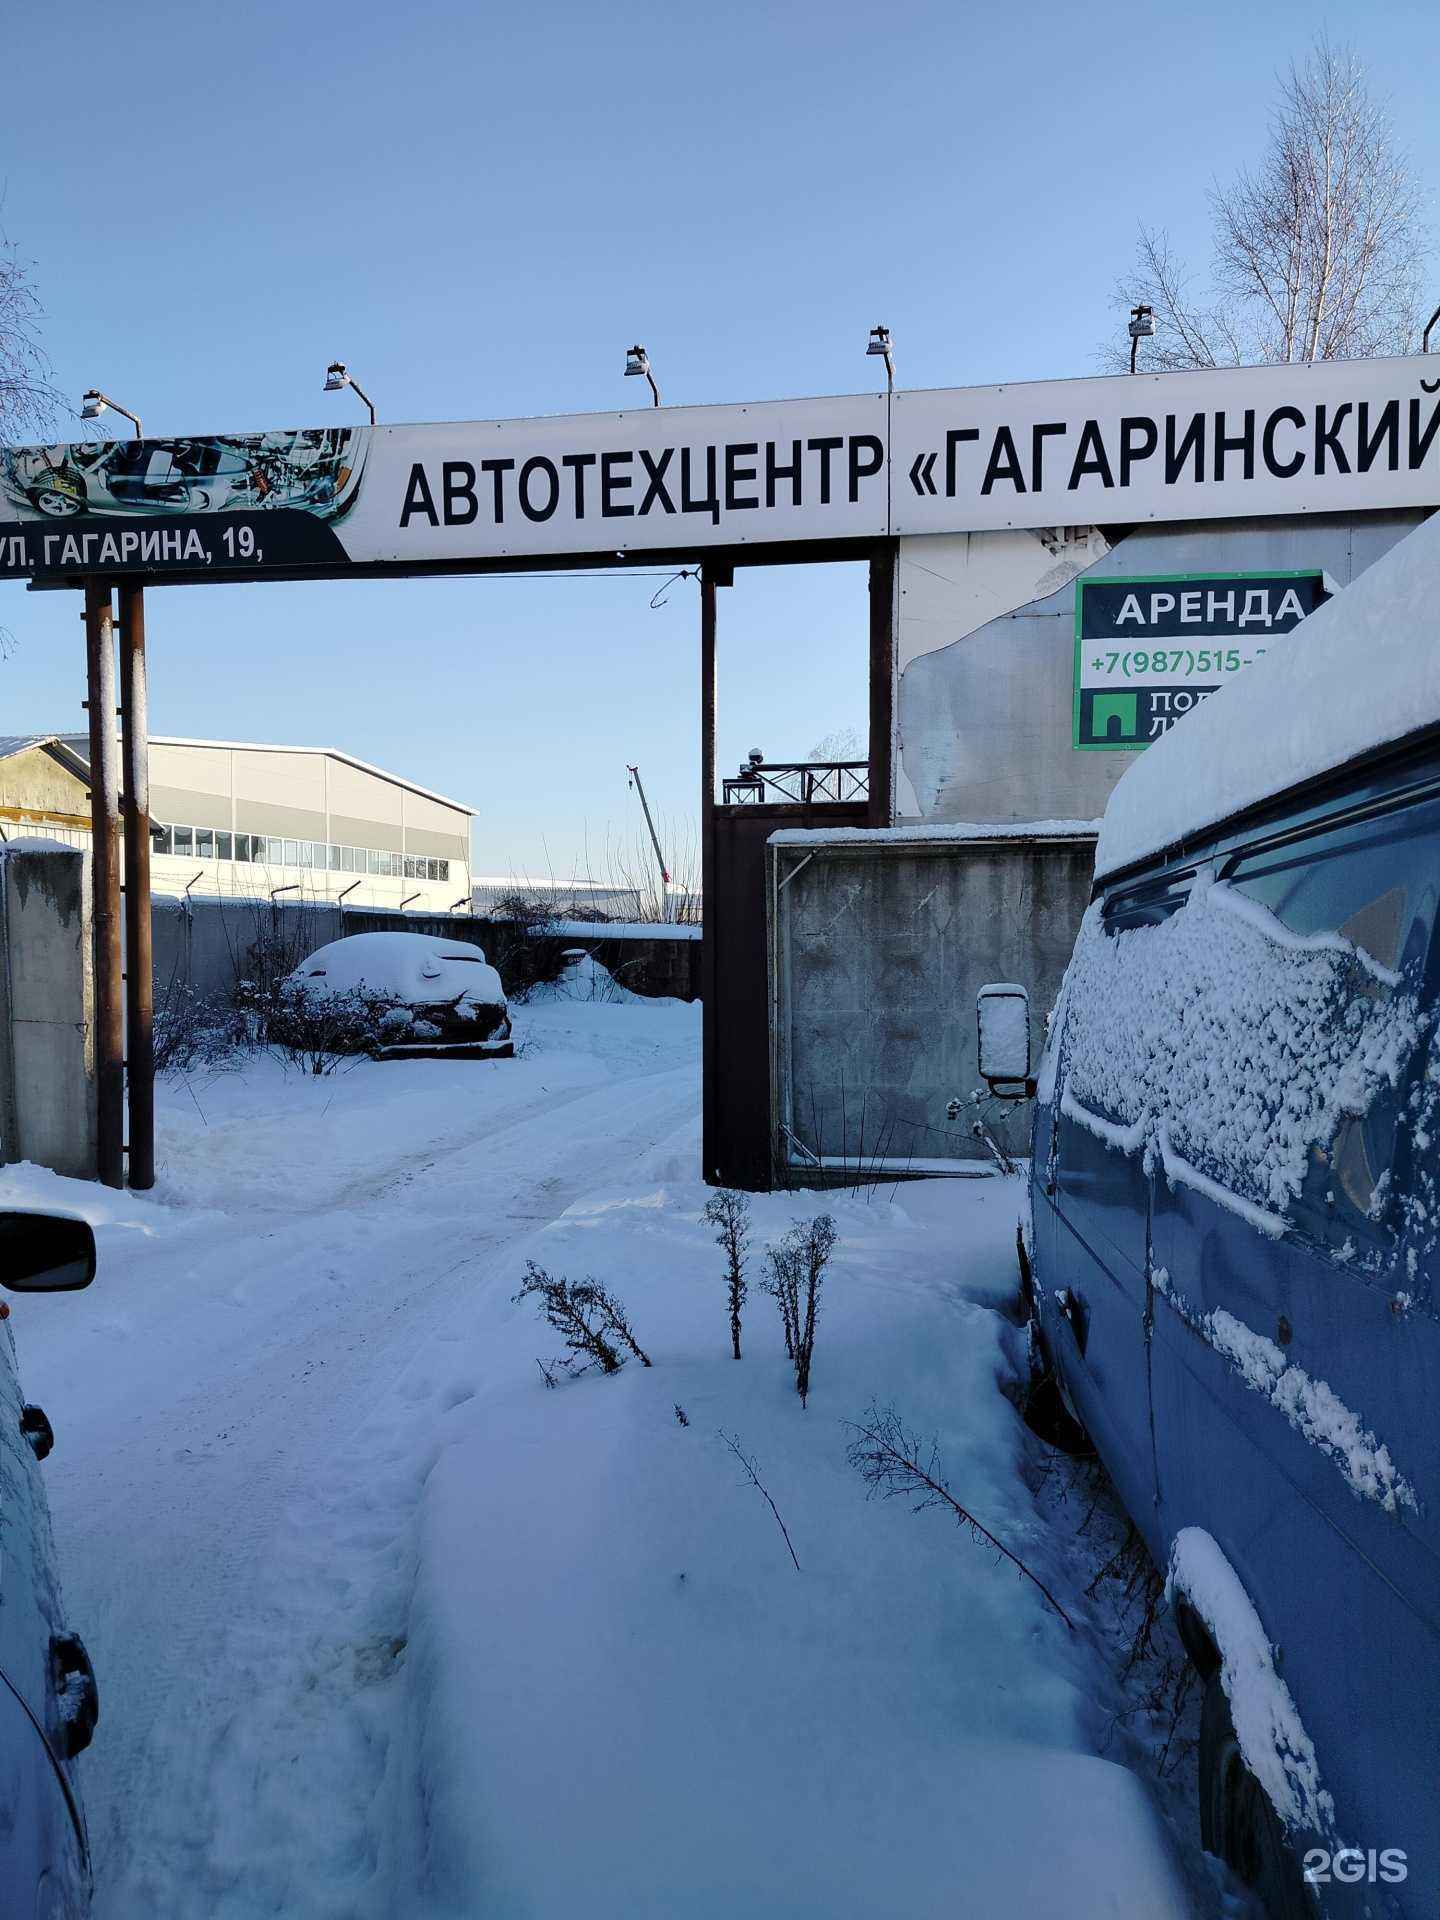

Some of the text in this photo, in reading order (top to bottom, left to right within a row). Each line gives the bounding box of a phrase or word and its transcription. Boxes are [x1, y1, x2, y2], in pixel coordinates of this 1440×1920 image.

[399, 378, 1440, 528] АВТОТЕХЦЕНТР «ГАГАРИНСКИЙ
[43, 528, 212, 566] ГАГАРИНА,
[222, 526, 263, 563] 19,
[1114, 588, 1306, 628] АРЕНДА
[1091, 649, 1267, 677] +7(987)515-
